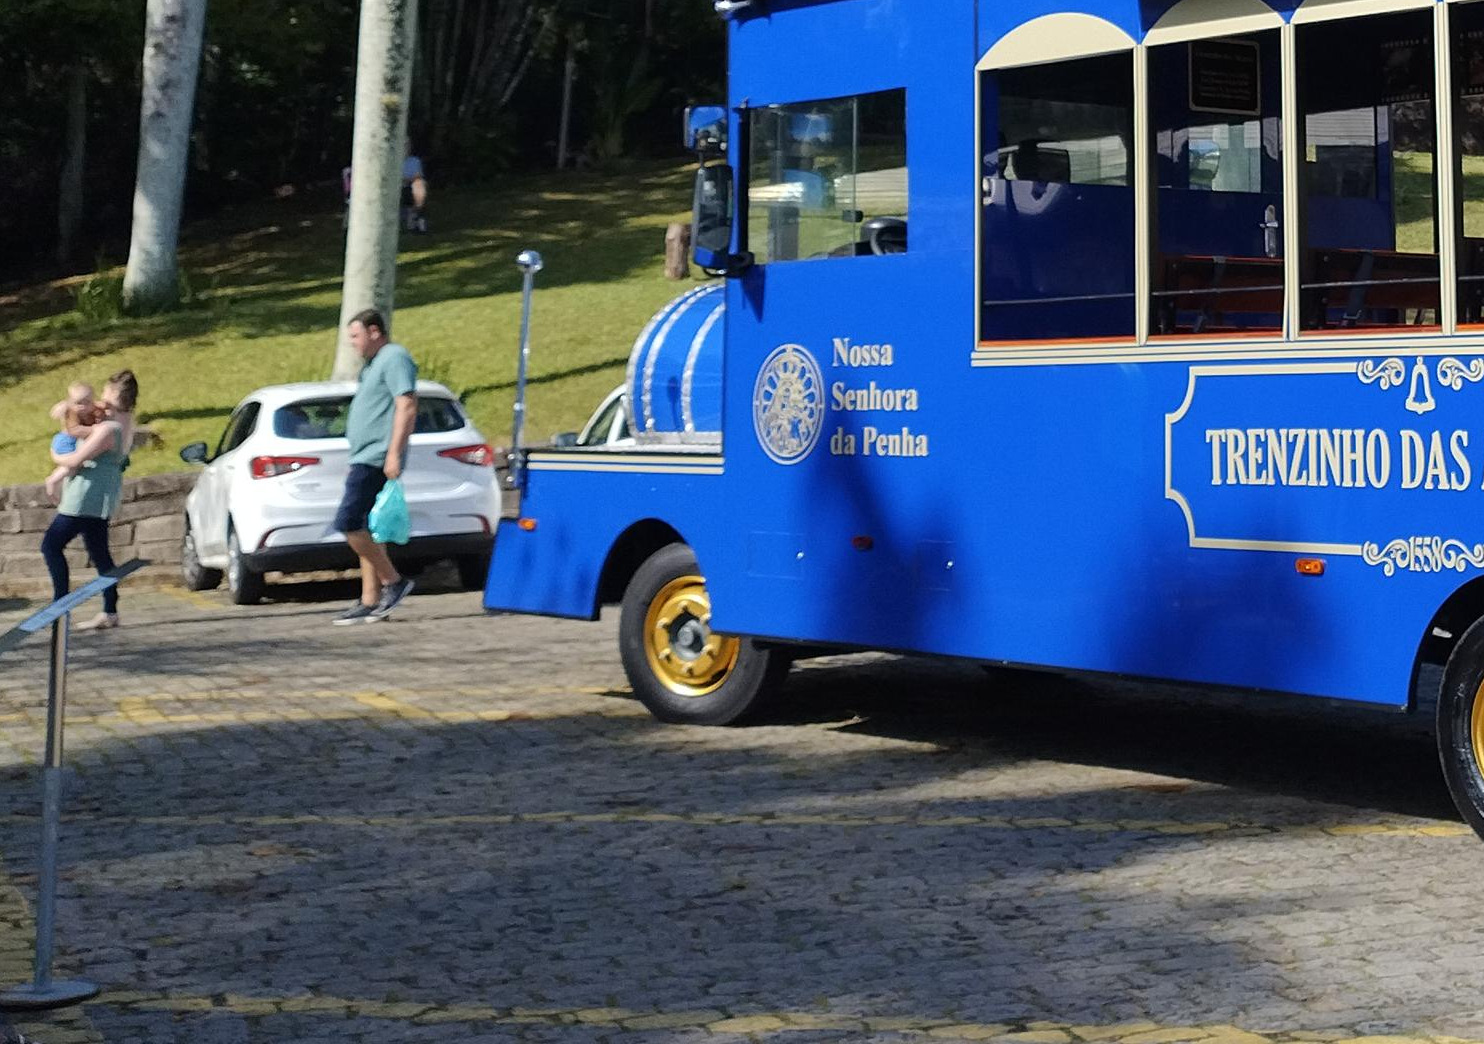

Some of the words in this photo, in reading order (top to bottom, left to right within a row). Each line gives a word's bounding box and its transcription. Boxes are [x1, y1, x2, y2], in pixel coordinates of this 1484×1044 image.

[832, 337, 893, 367] Nossa
[832, 380, 918, 411] Senhora
[830, 427, 855, 455] da
[863, 426, 929, 456] Penha
[1205, 427, 1390, 489] TRENZINHO
[1399, 429, 1472, 491] DAS
[1408, 536, 1441, 573] 1558
